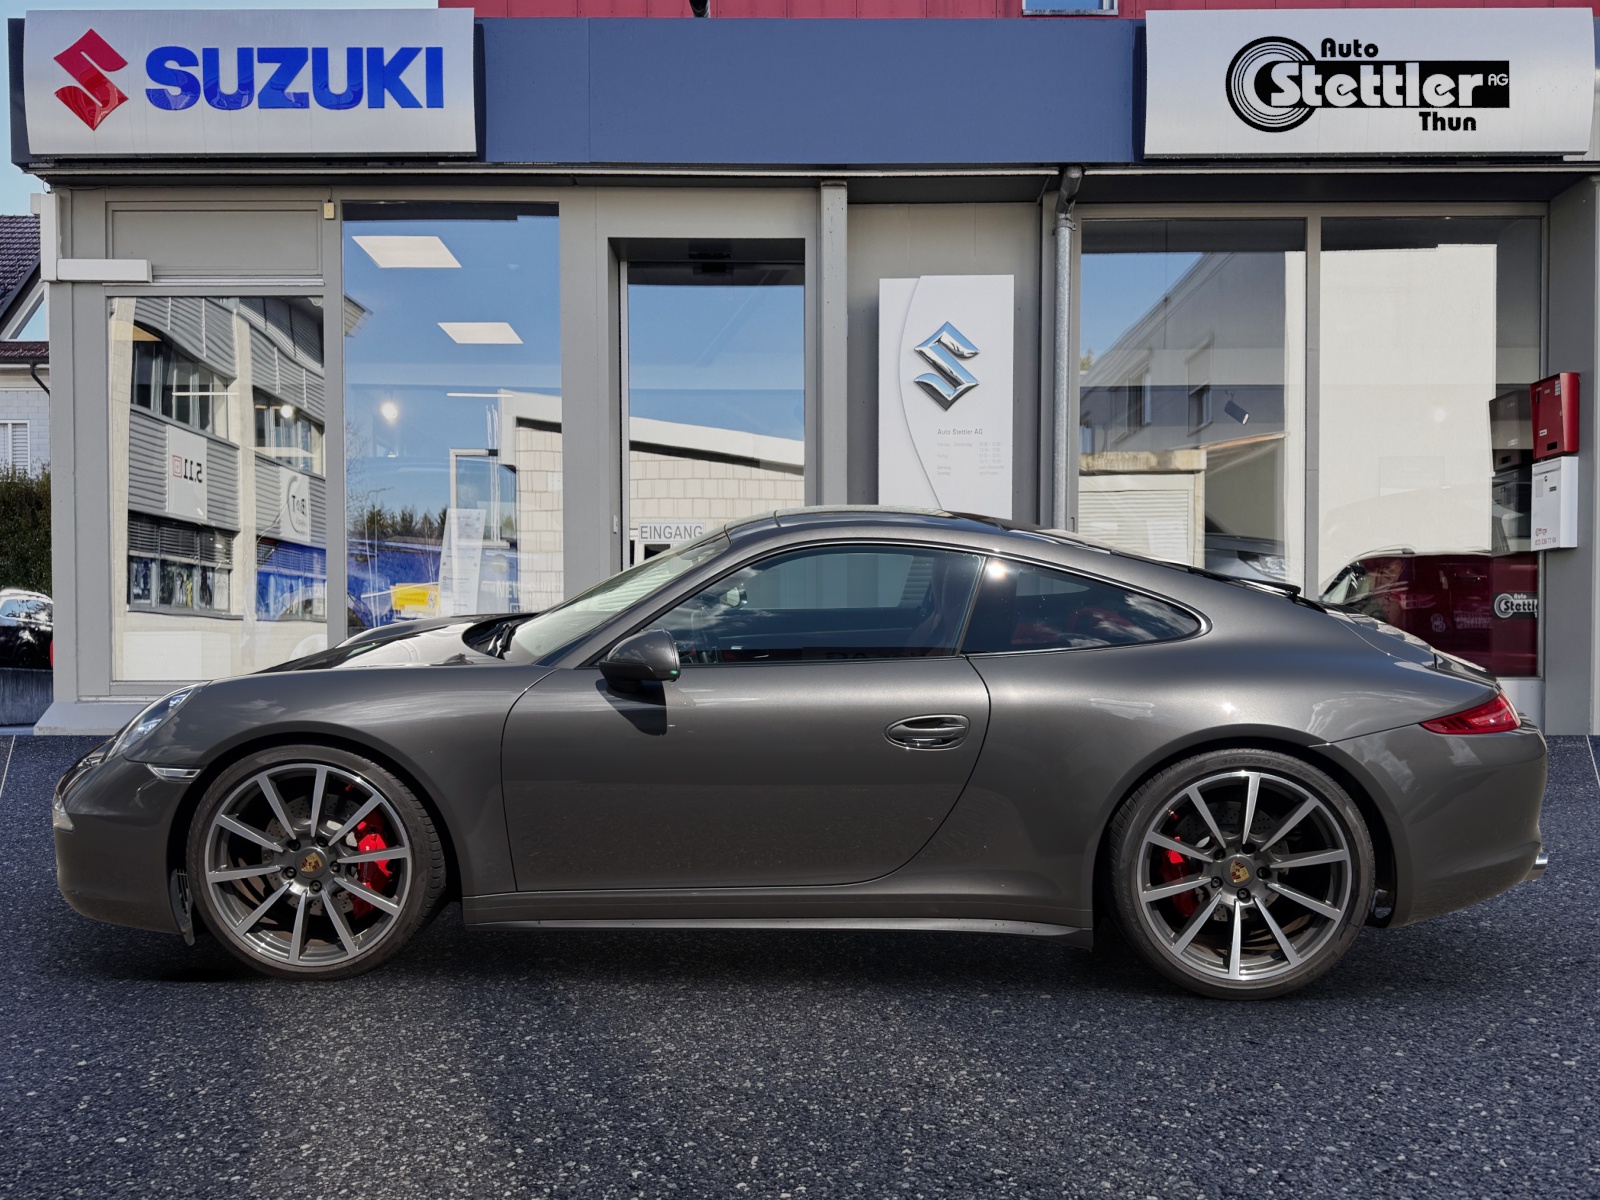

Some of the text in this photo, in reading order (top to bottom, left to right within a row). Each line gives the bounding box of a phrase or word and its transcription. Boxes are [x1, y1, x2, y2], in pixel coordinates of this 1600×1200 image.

[1321, 37, 1379, 58] Auto
[145, 45, 444, 111] SUZUKI
[1270, 61, 1509, 107] Stettler AG
[1419, 111, 1477, 131] Thun
[640, 525, 703, 539] EINGANG
